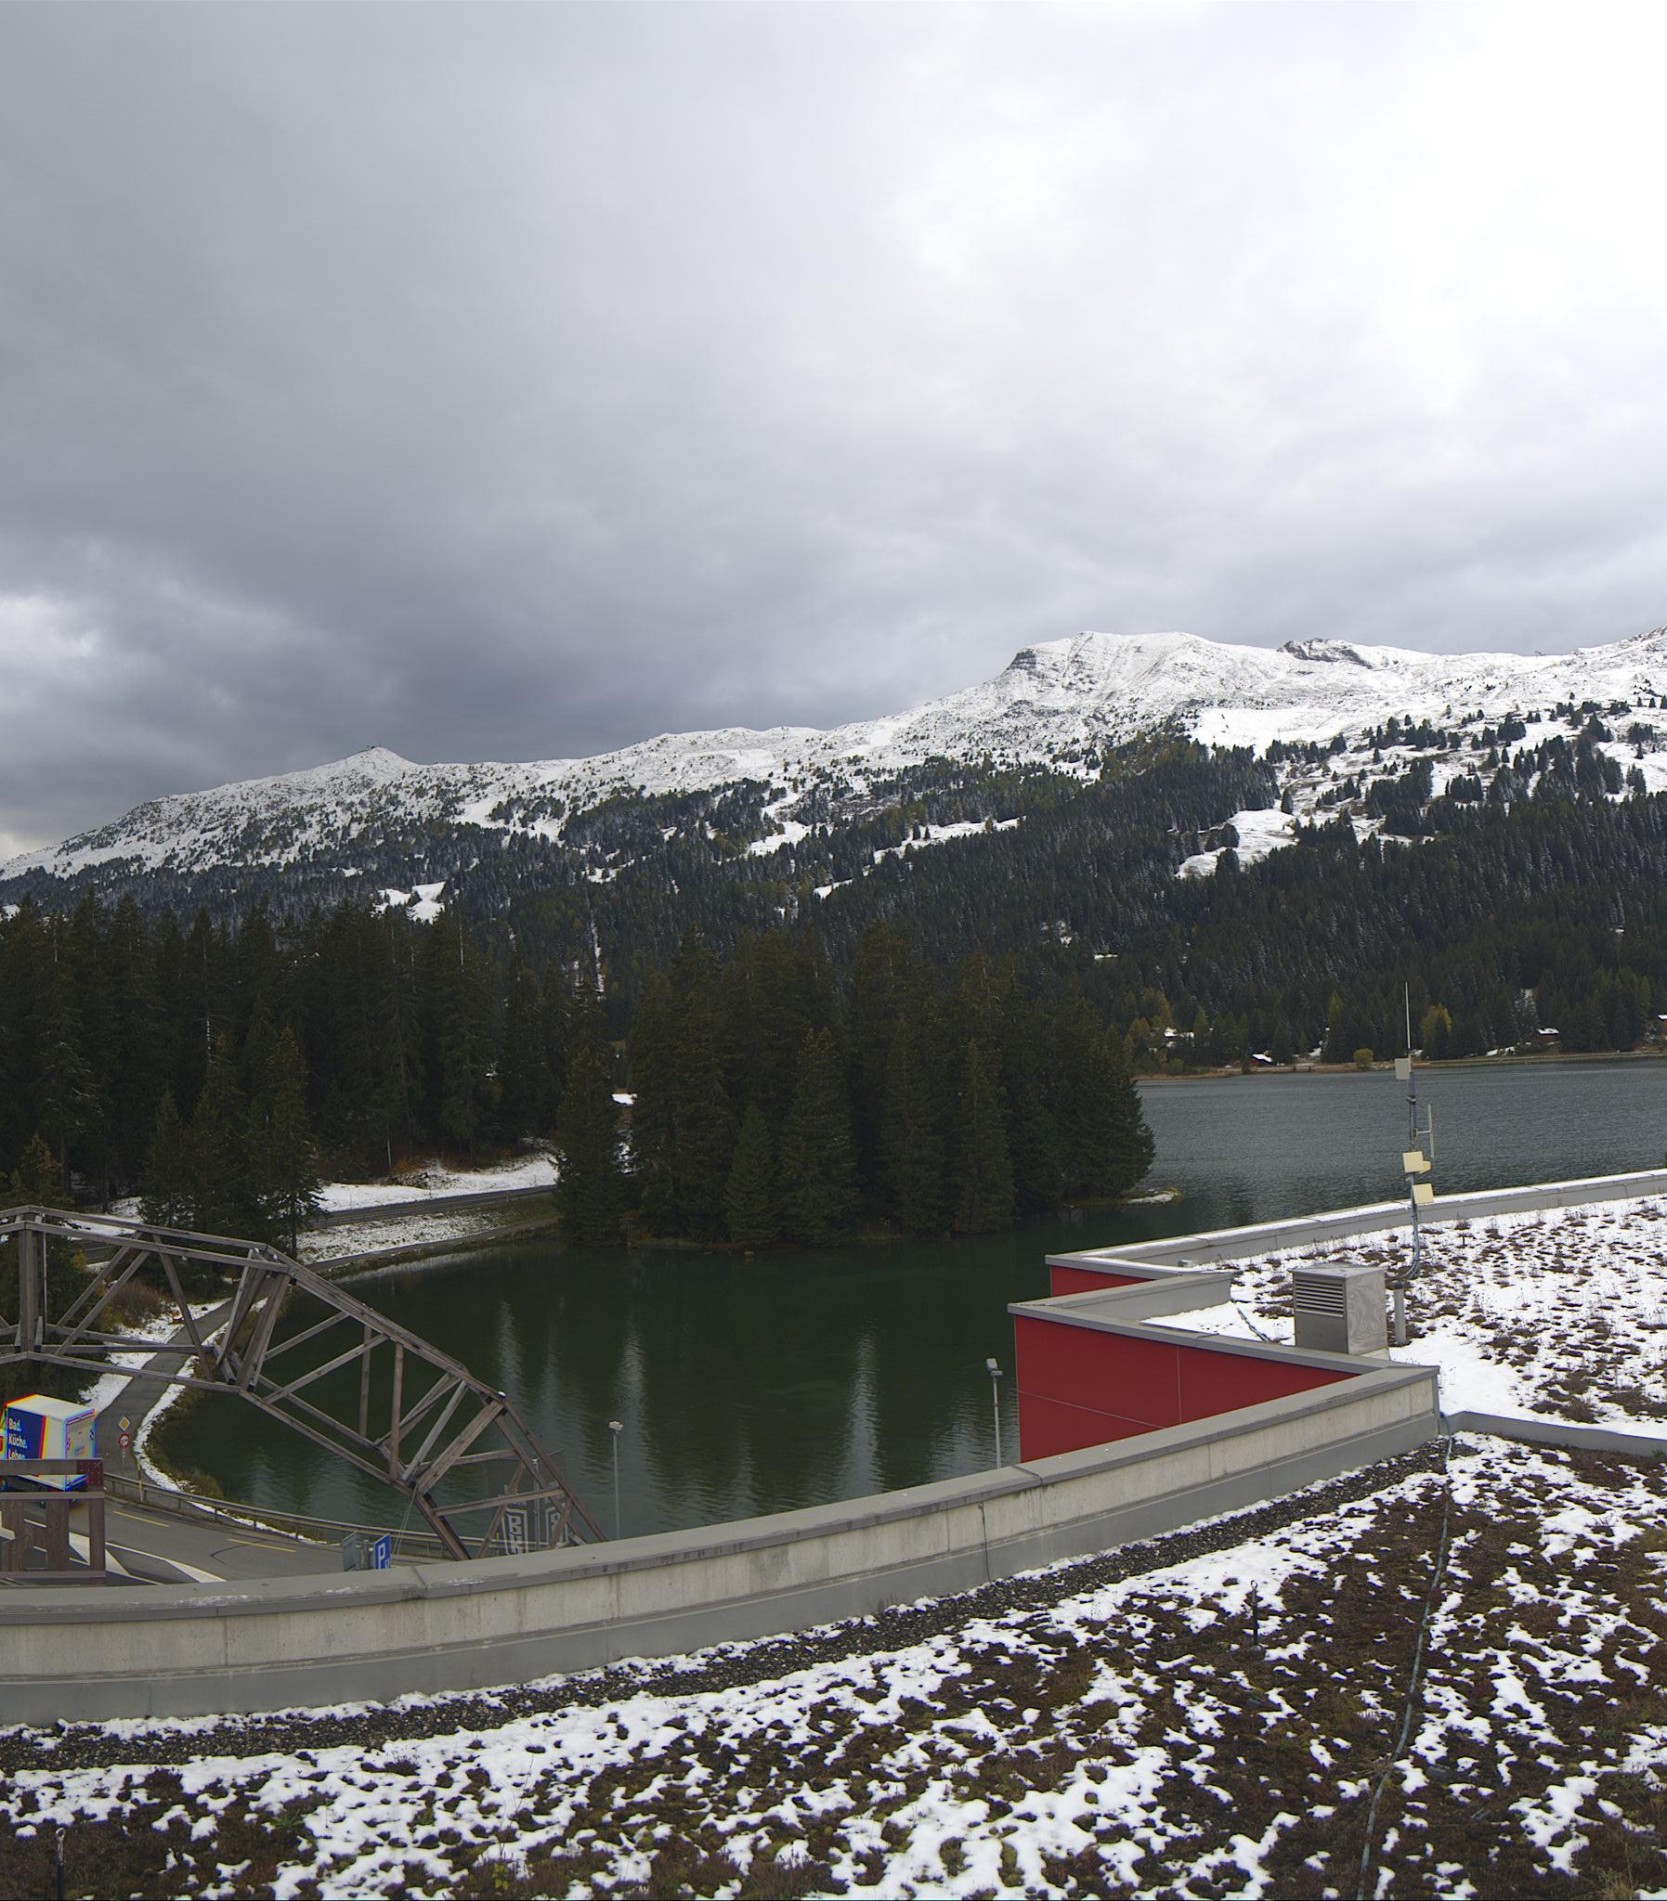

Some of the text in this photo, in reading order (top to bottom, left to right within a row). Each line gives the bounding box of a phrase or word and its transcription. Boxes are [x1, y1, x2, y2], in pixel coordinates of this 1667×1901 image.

[9, 1418, 22, 1432] Bad.
[9, 1433, 28, 1449] Küche.
[377, 1541, 386, 1569] P
